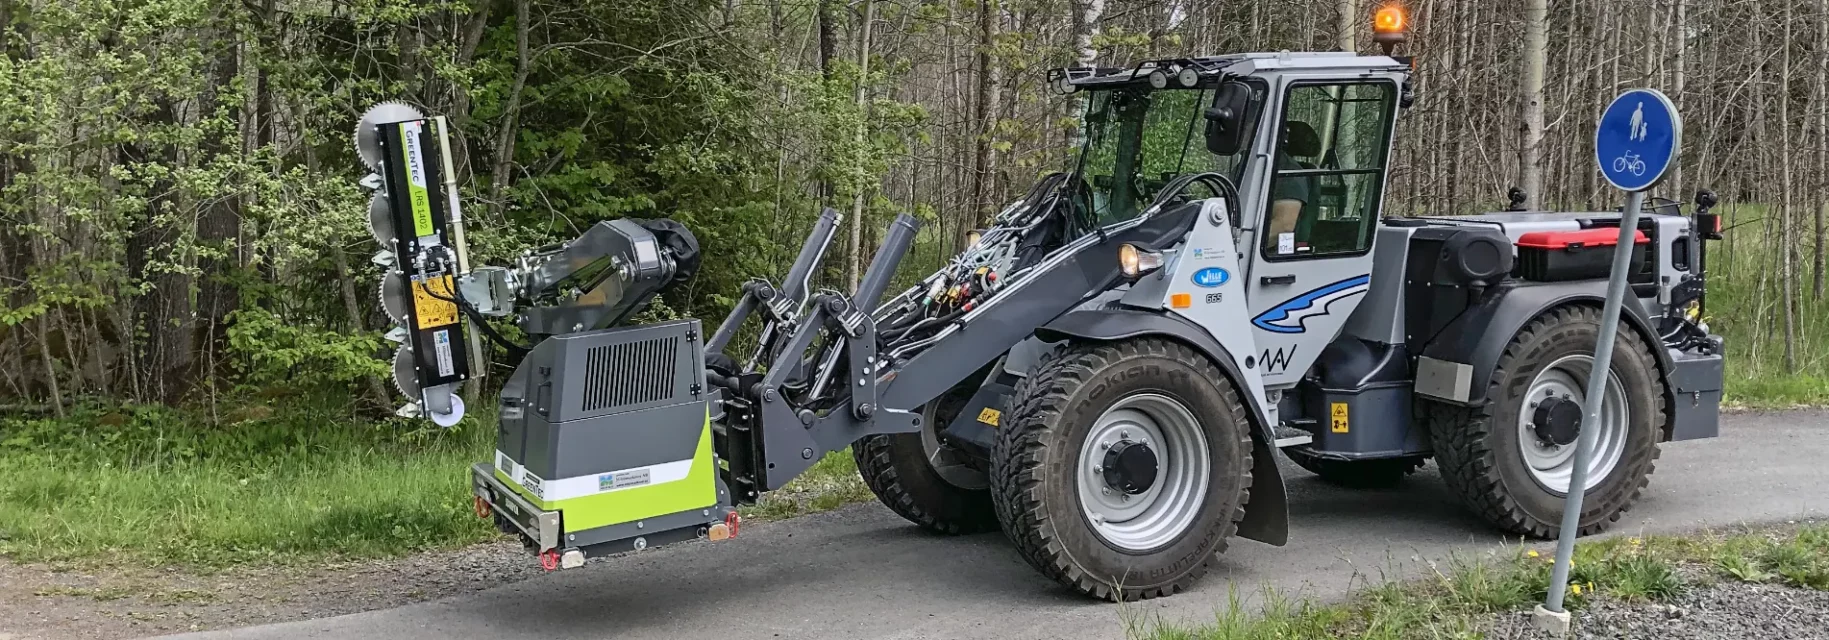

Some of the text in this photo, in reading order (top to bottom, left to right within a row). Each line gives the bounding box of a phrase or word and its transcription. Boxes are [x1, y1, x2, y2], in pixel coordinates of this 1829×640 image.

[414, 190, 428, 230] LRS 1402
[1206, 293, 1222, 304] 665
